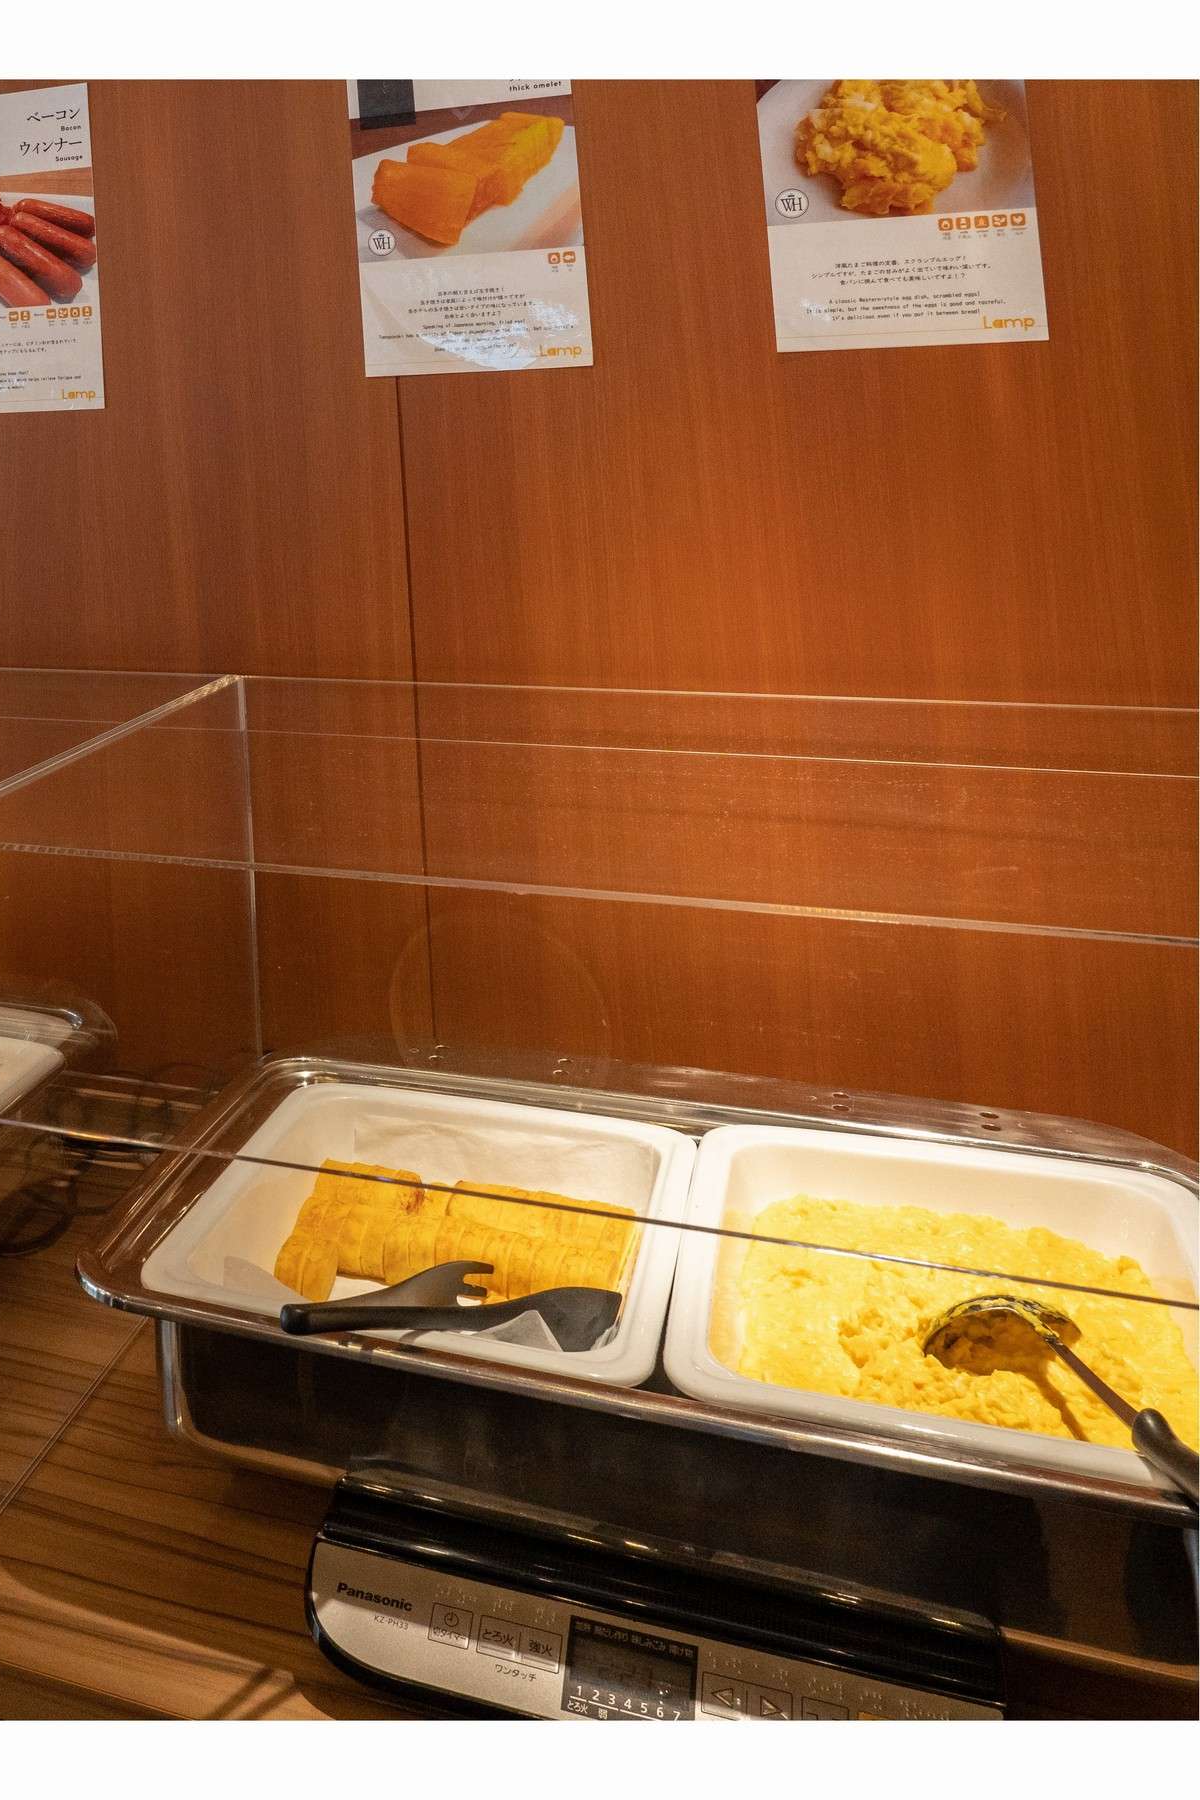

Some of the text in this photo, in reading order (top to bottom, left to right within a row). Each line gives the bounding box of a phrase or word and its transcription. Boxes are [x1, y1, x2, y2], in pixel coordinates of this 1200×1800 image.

[533, 80, 561, 89] omelet
[26, 108, 80, 121] ベーコン
[19, 137, 82, 156] ウィンナー
[983, 315, 1035, 332] Lamp
[539, 343, 582, 360] Lamp
[62, 388, 96, 401] Lamp
[336, 1582, 414, 1613] Panasonic
[373, 1615, 409, 1631] KZ-PH33
[481, 1629, 515, 1647] とろ火
[528, 1639, 553, 1657] 強火
[495, 1663, 537, 1682] ワンタッチ
[567, 1700, 588, 1714] とろ火
